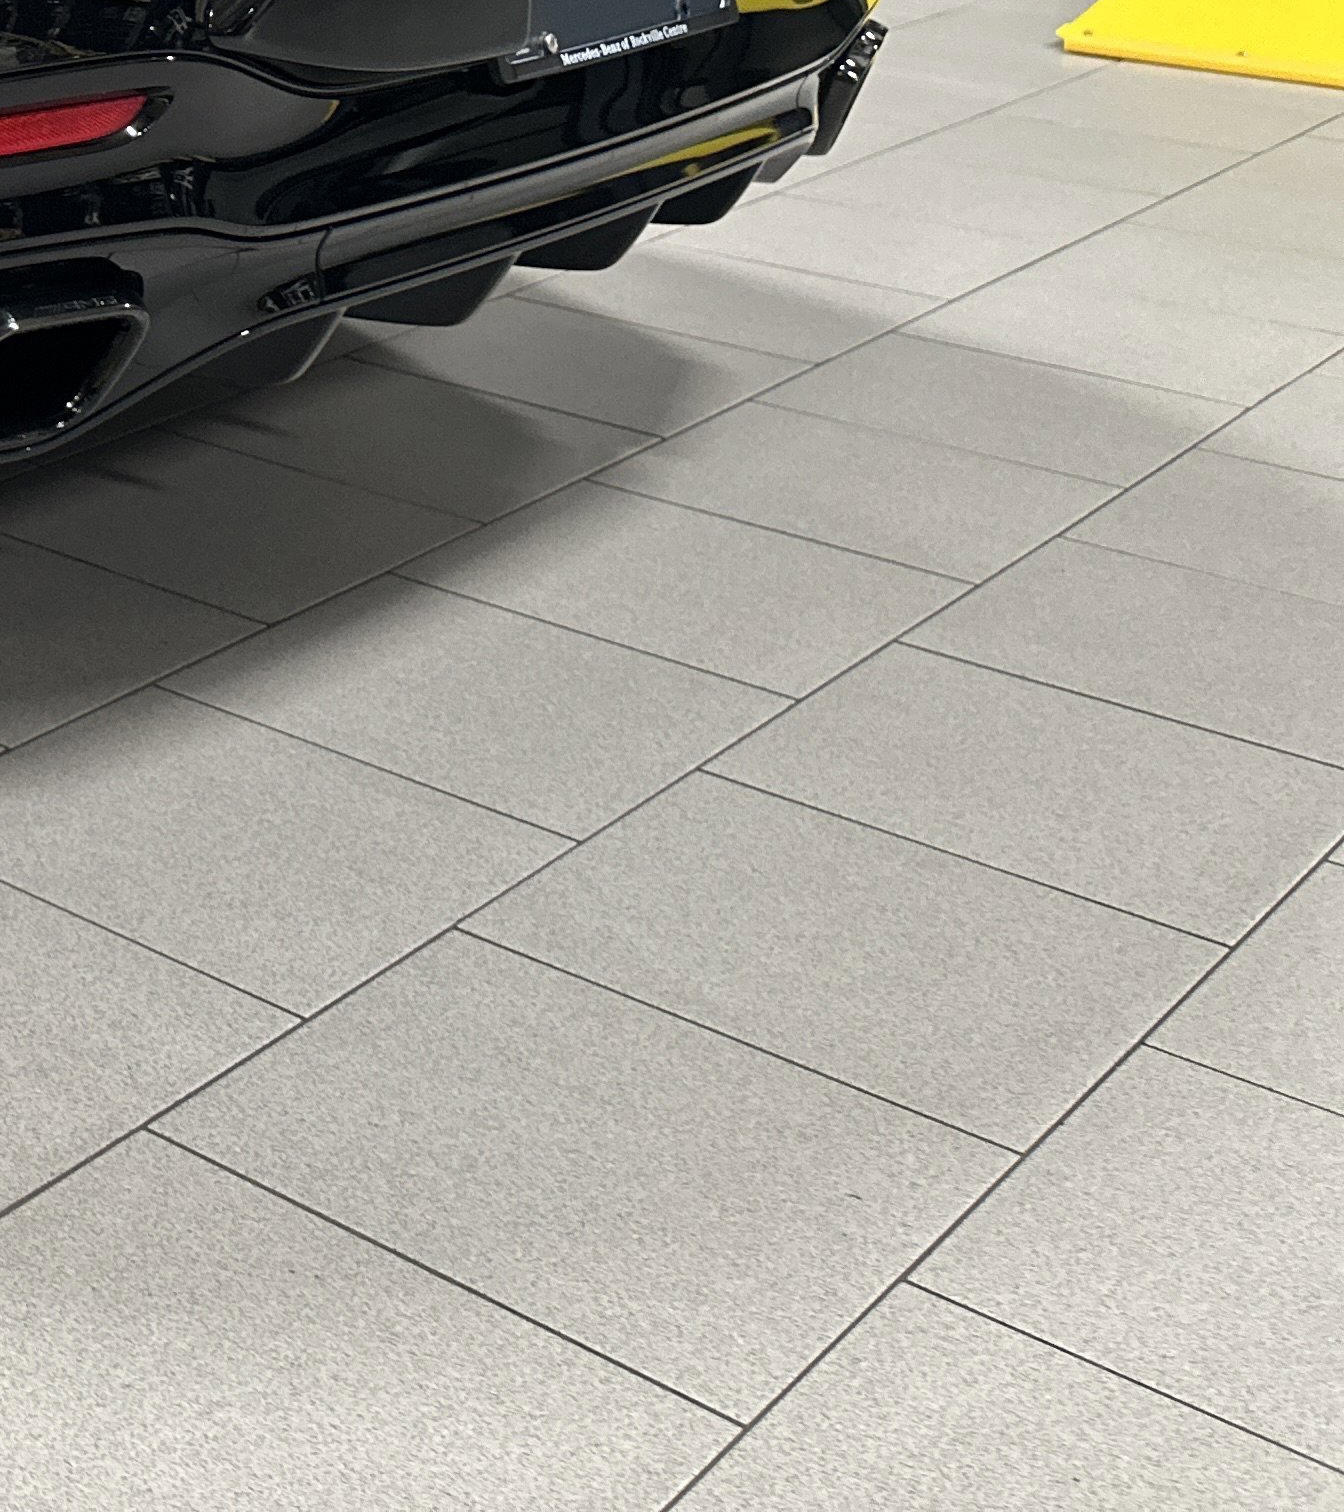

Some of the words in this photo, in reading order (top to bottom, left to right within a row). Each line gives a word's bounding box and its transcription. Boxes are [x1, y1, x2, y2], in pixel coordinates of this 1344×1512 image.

[560, 43, 622, 66] Mercedes-Benz
[621, 36, 630, 51] of
[629, 28, 664, 48] Rockville
[662, 23, 688, 39] Centre
